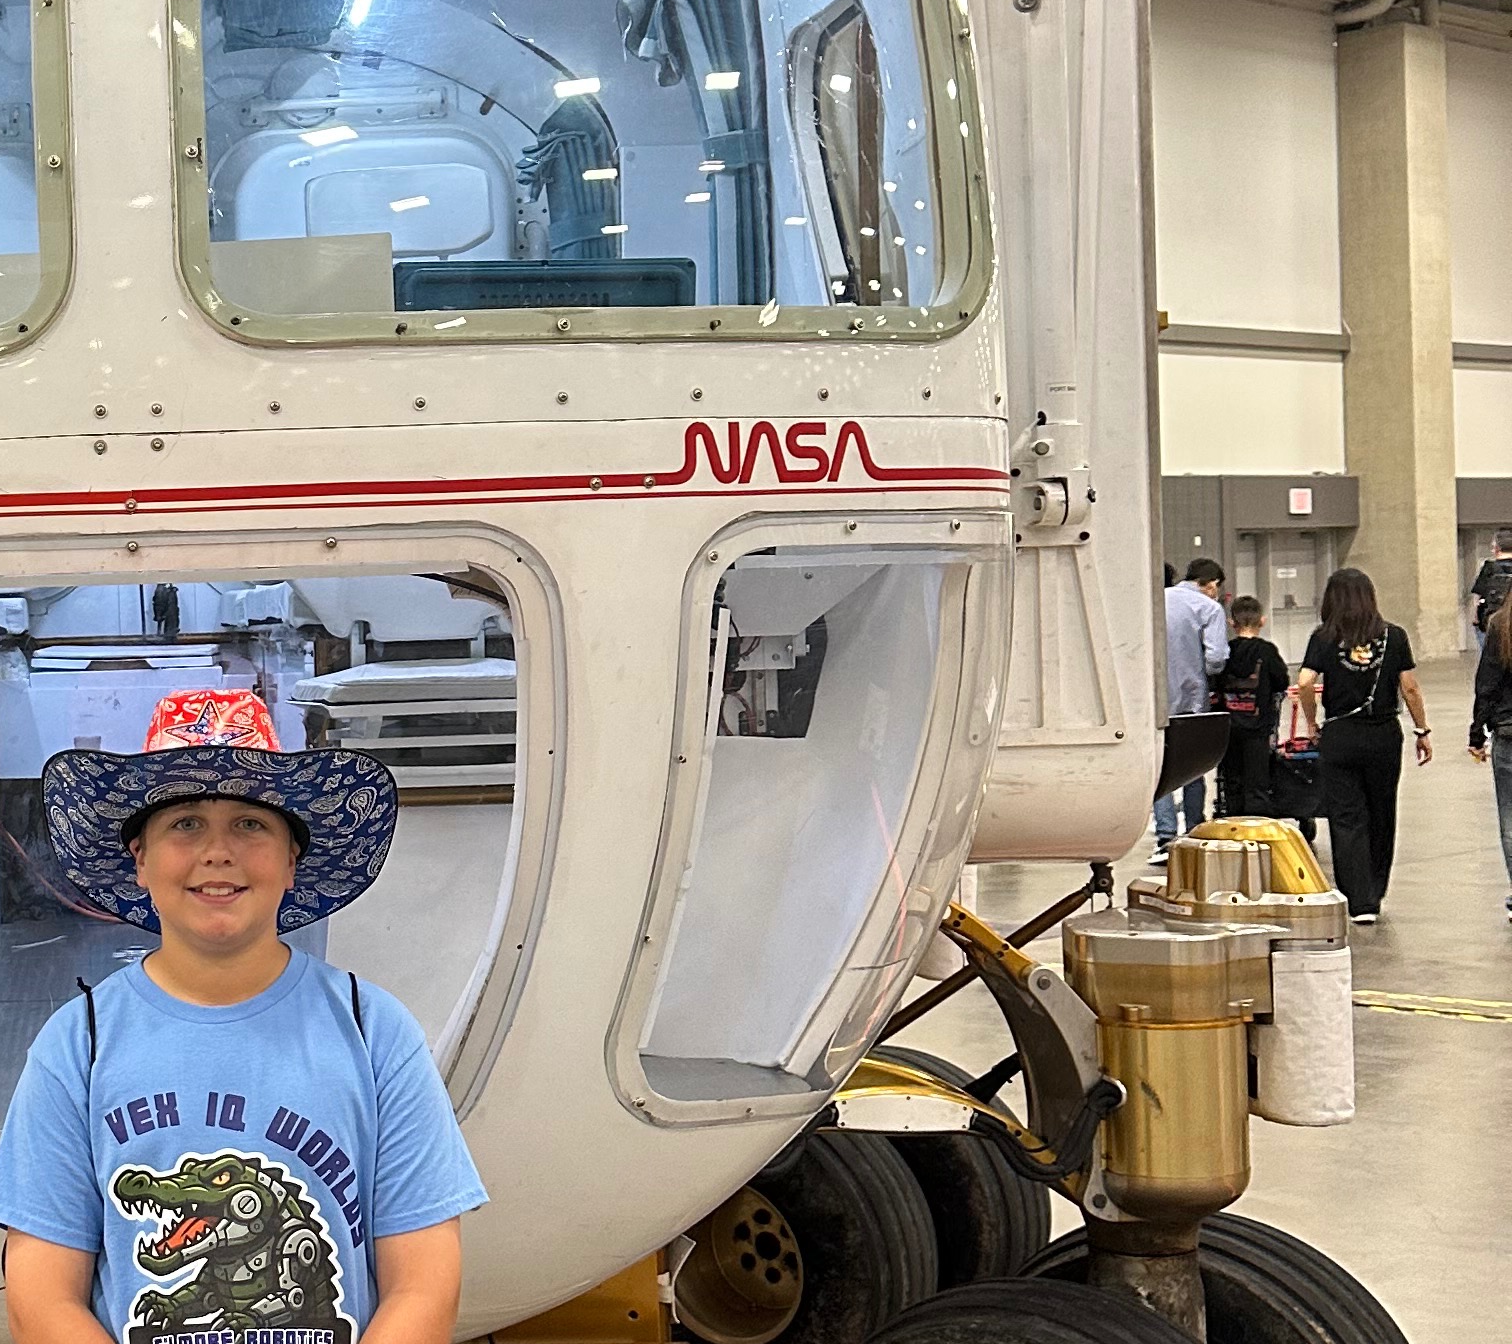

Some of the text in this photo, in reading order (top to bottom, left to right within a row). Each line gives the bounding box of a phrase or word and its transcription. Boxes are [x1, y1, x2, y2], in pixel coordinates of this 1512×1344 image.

[681, 420, 882, 485] NASA
[104, 1091, 366, 1249] VEX IQ WORLDS
